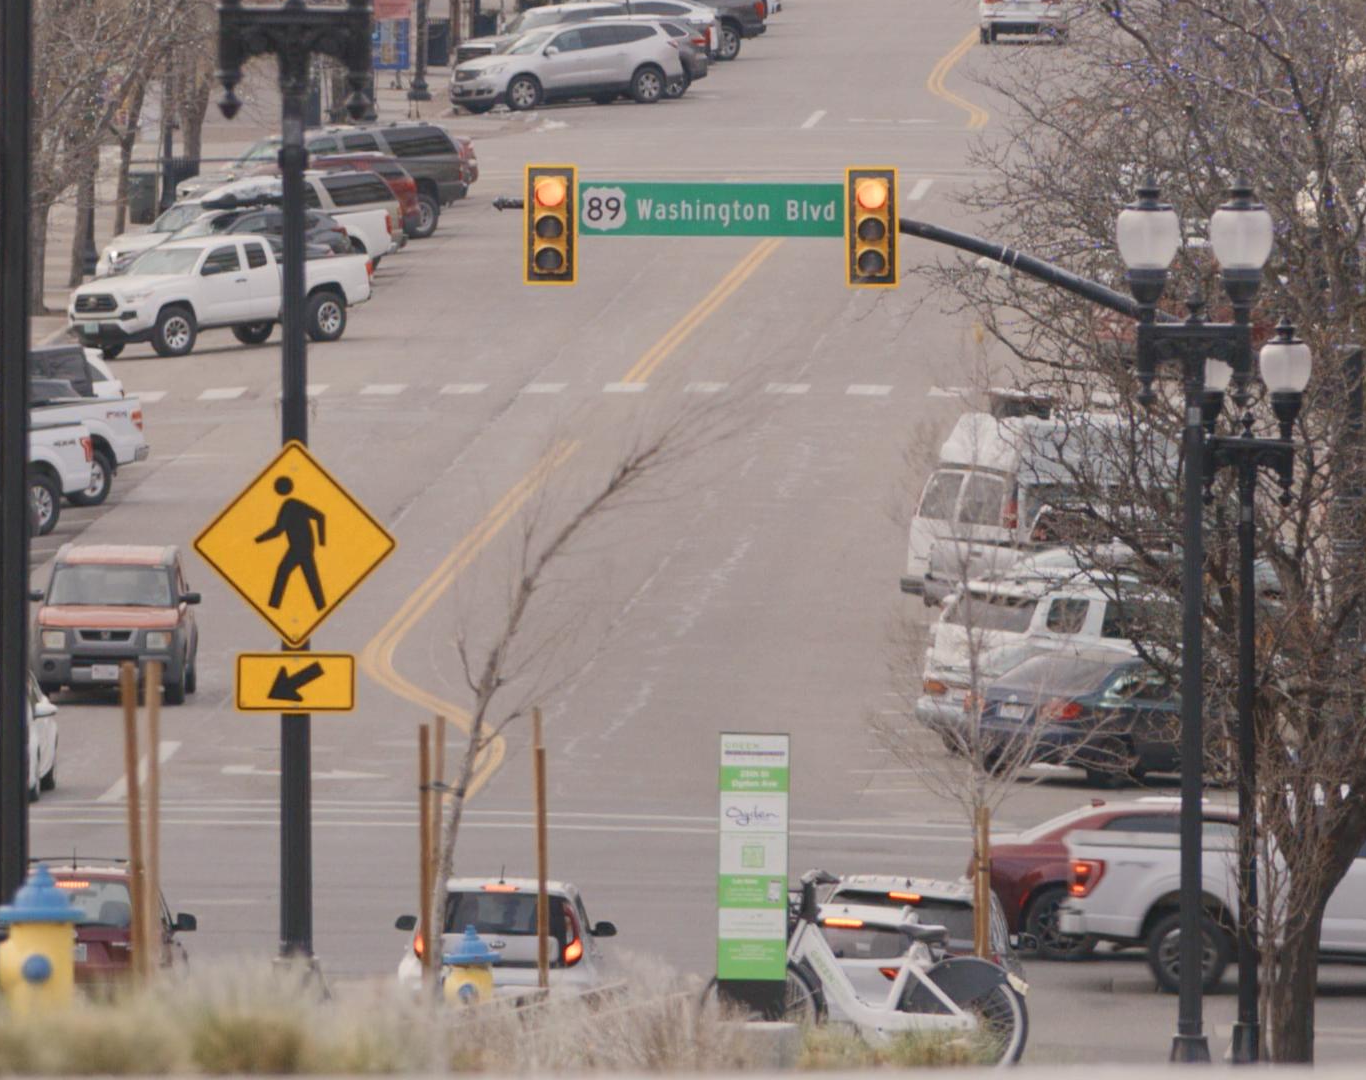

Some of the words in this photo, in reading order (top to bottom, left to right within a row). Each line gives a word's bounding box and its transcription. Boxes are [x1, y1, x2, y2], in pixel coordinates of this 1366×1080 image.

[586, 196, 621, 221] 89
[636, 198, 770, 227] Washington
[786, 199, 836, 222] Blvd
[725, 805, 781, 826] Ogden
